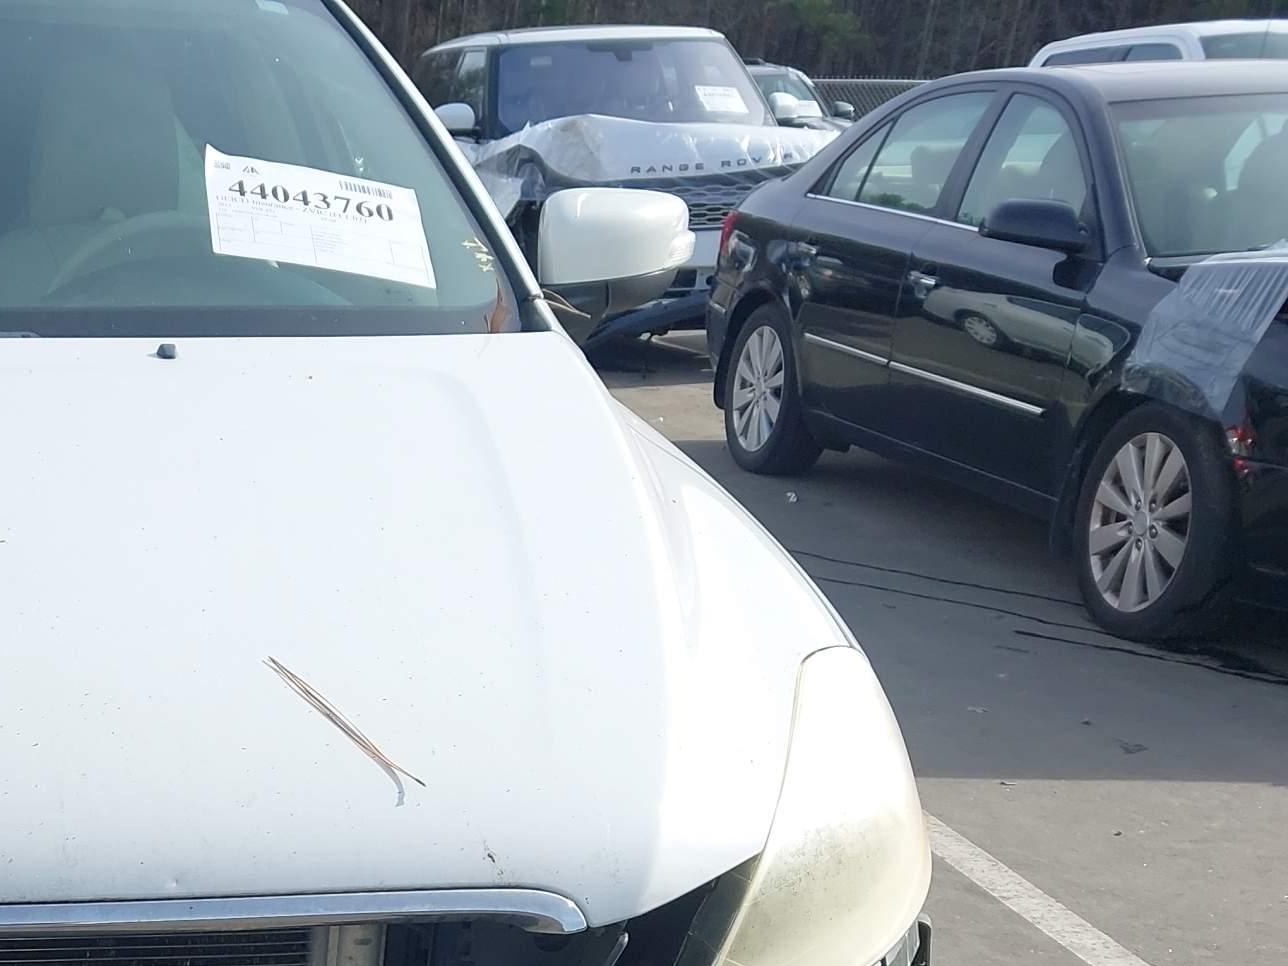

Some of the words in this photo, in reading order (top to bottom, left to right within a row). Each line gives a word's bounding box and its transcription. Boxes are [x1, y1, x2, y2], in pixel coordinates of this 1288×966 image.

[631, 163, 704, 174] RANGE
[721, 153, 793, 168] ROVR
[229, 180, 393, 221] 44043760
